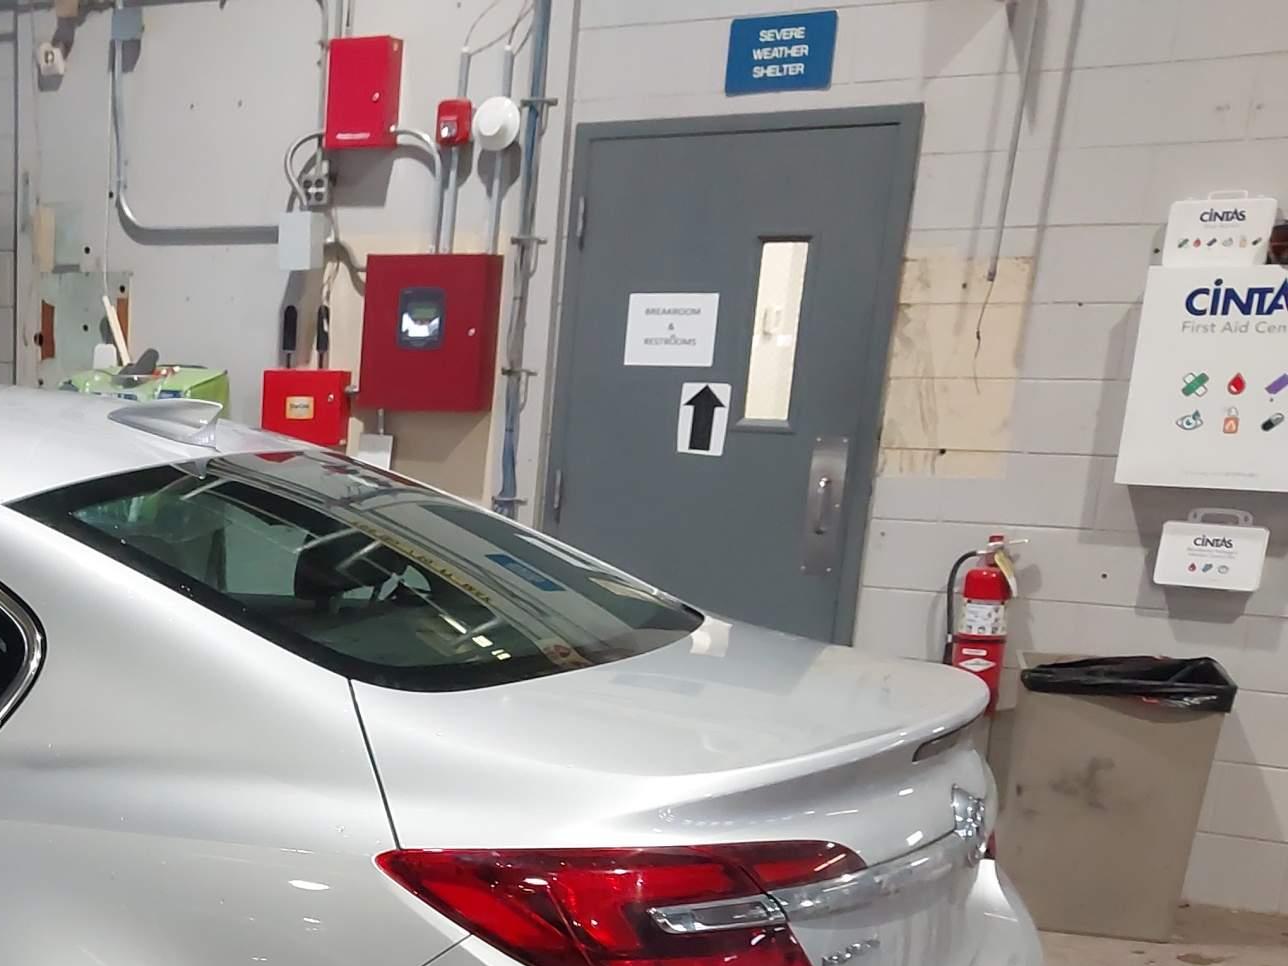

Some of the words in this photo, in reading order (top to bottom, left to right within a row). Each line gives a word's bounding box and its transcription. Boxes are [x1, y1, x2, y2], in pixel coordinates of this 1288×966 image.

[759, 27, 806, 42] SEVERE
[753, 45, 809, 60] WEATHER
[753, 63, 805, 78] SHELTER
[645, 307, 702, 316] BREAKROOM
[1181, 320, 1217, 333] First
[1221, 320, 1250, 333] Aid
[643, 337, 697, 347] RESTROOMS
